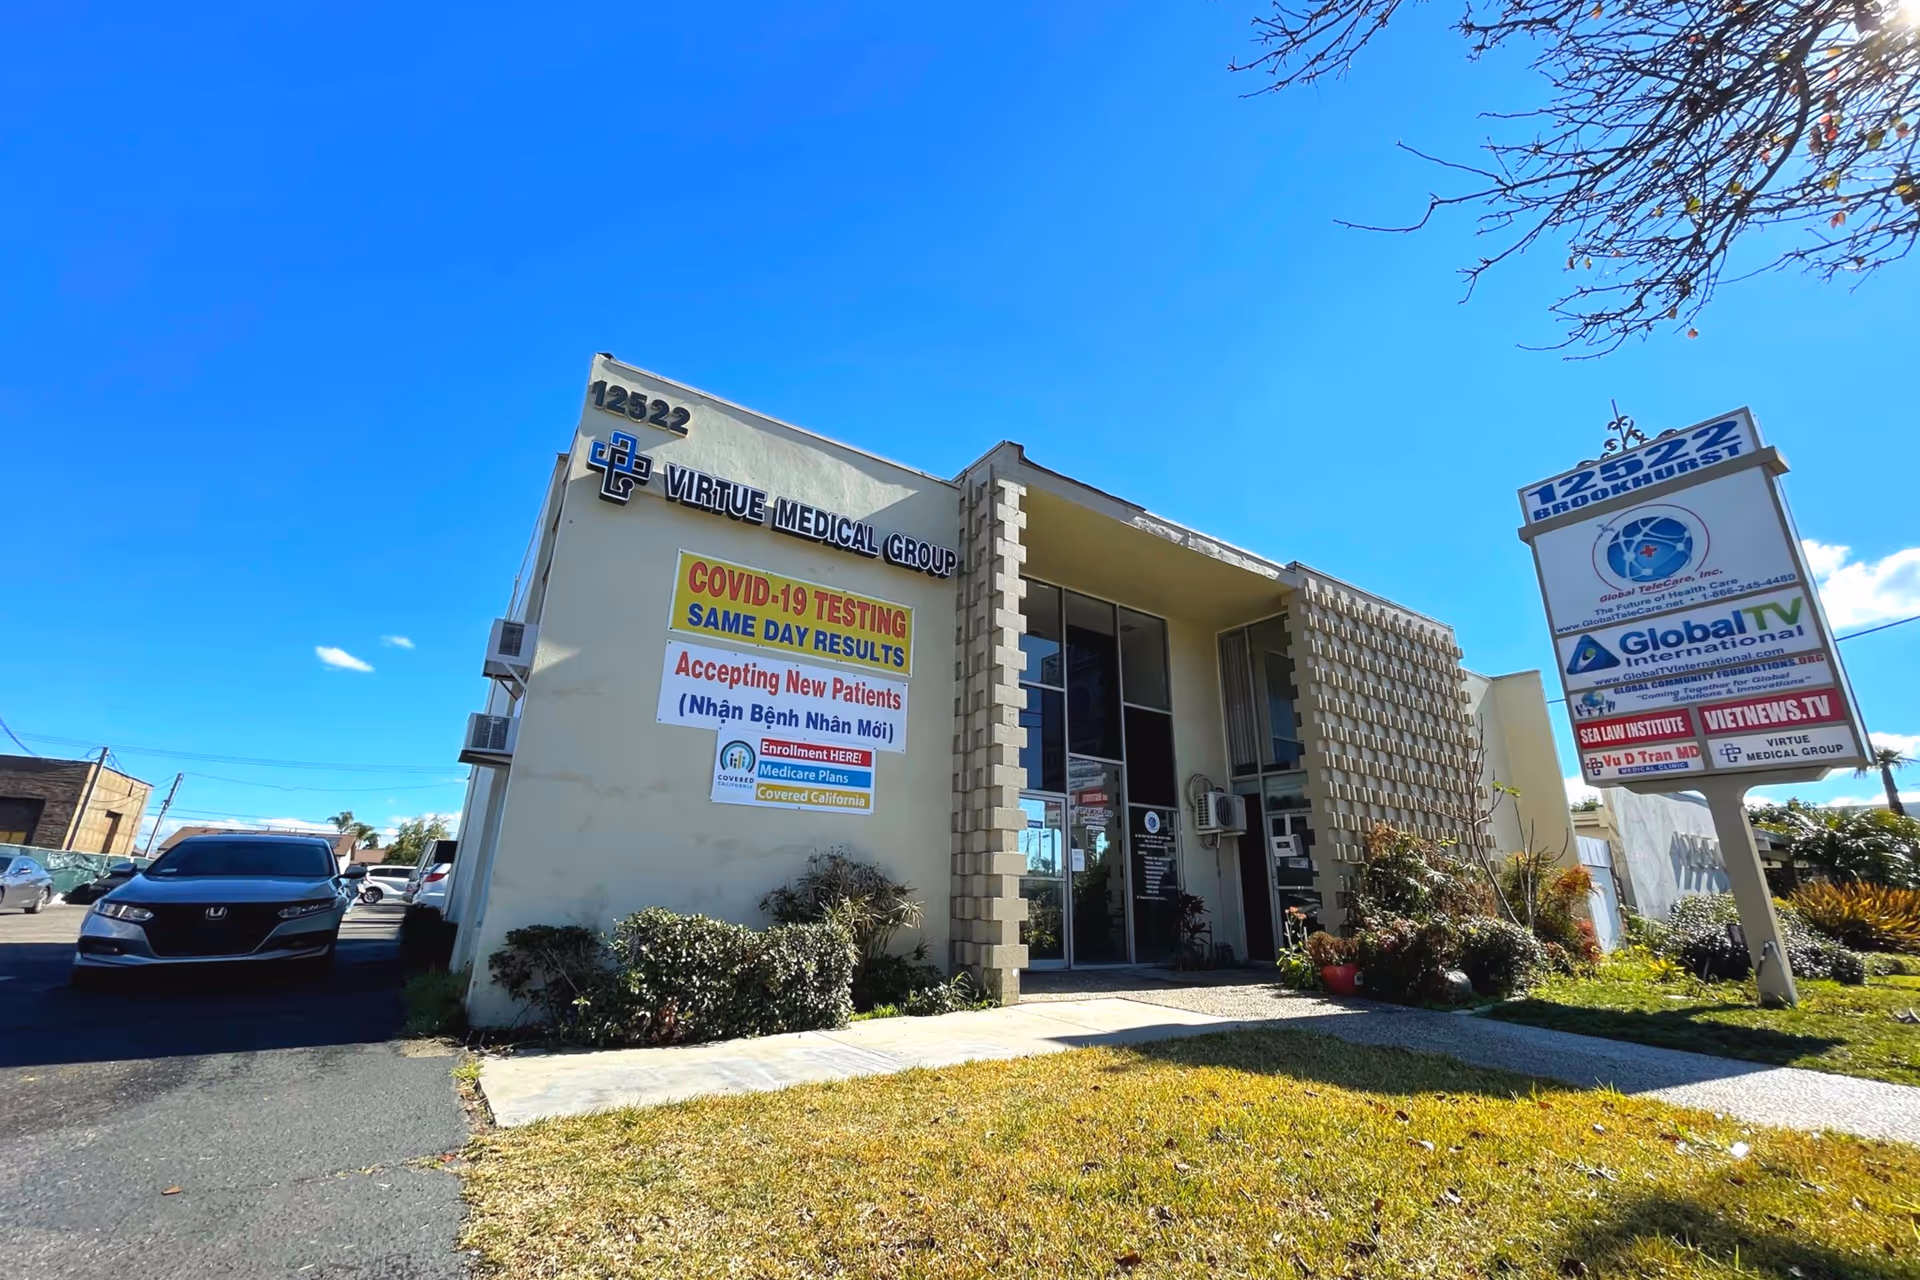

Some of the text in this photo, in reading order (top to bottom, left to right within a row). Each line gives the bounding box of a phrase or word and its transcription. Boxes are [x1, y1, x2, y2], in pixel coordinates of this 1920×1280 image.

[591, 380, 690, 437] 12522
[1528, 420, 1741, 506] 12522
[1532, 441, 1743, 521] BROOKHURST
[664, 461, 958, 577] VIRTUE MEDICAL GROUP
[689, 561, 906, 638] COVID-19 TESTING
[1594, 578, 1738, 616] The Future of Health Care
[1600, 568, 1723, 603] Global TeleCare, Inc.
[687, 603, 904, 667] SAME DAY RESULTS
[1619, 596, 1803, 655] GlobalTV
[1625, 625, 1805, 667] International
[674, 651, 901, 710] Accepting New Patients
[1594, 648, 1785, 686] www.GlobalTVInternational.com
[1614, 682, 1650, 695] GLOBAL
[1651, 671, 1714, 689] COMMUNITY
[1683, 682, 1730, 695] Together
[1733, 679, 1748, 687] for
[1752, 672, 1790, 683] Global
[1672, 690, 1722, 702] Solutions
[1704, 695, 1831, 730] VIETNEWS.TV
[679, 693, 894, 743] (Nhận Bệnh Nhân Mới)
[1580, 716, 1686, 743] SEA LAW INSTITUTE
[761, 741, 862, 764] Enrollment HERE!
[1602, 745, 1701, 767] Vu D Tran MD
[1746, 744, 1844, 761] MEDICAL GROUP
[1767, 734, 1810, 747] VIRTUE
[717, 774, 754, 784] COVERED
[760, 764, 849, 784] Medicare Plans
[1621, 762, 1686, 774] MEDICAL CLINIC
[757, 786, 865, 807] Covered California
